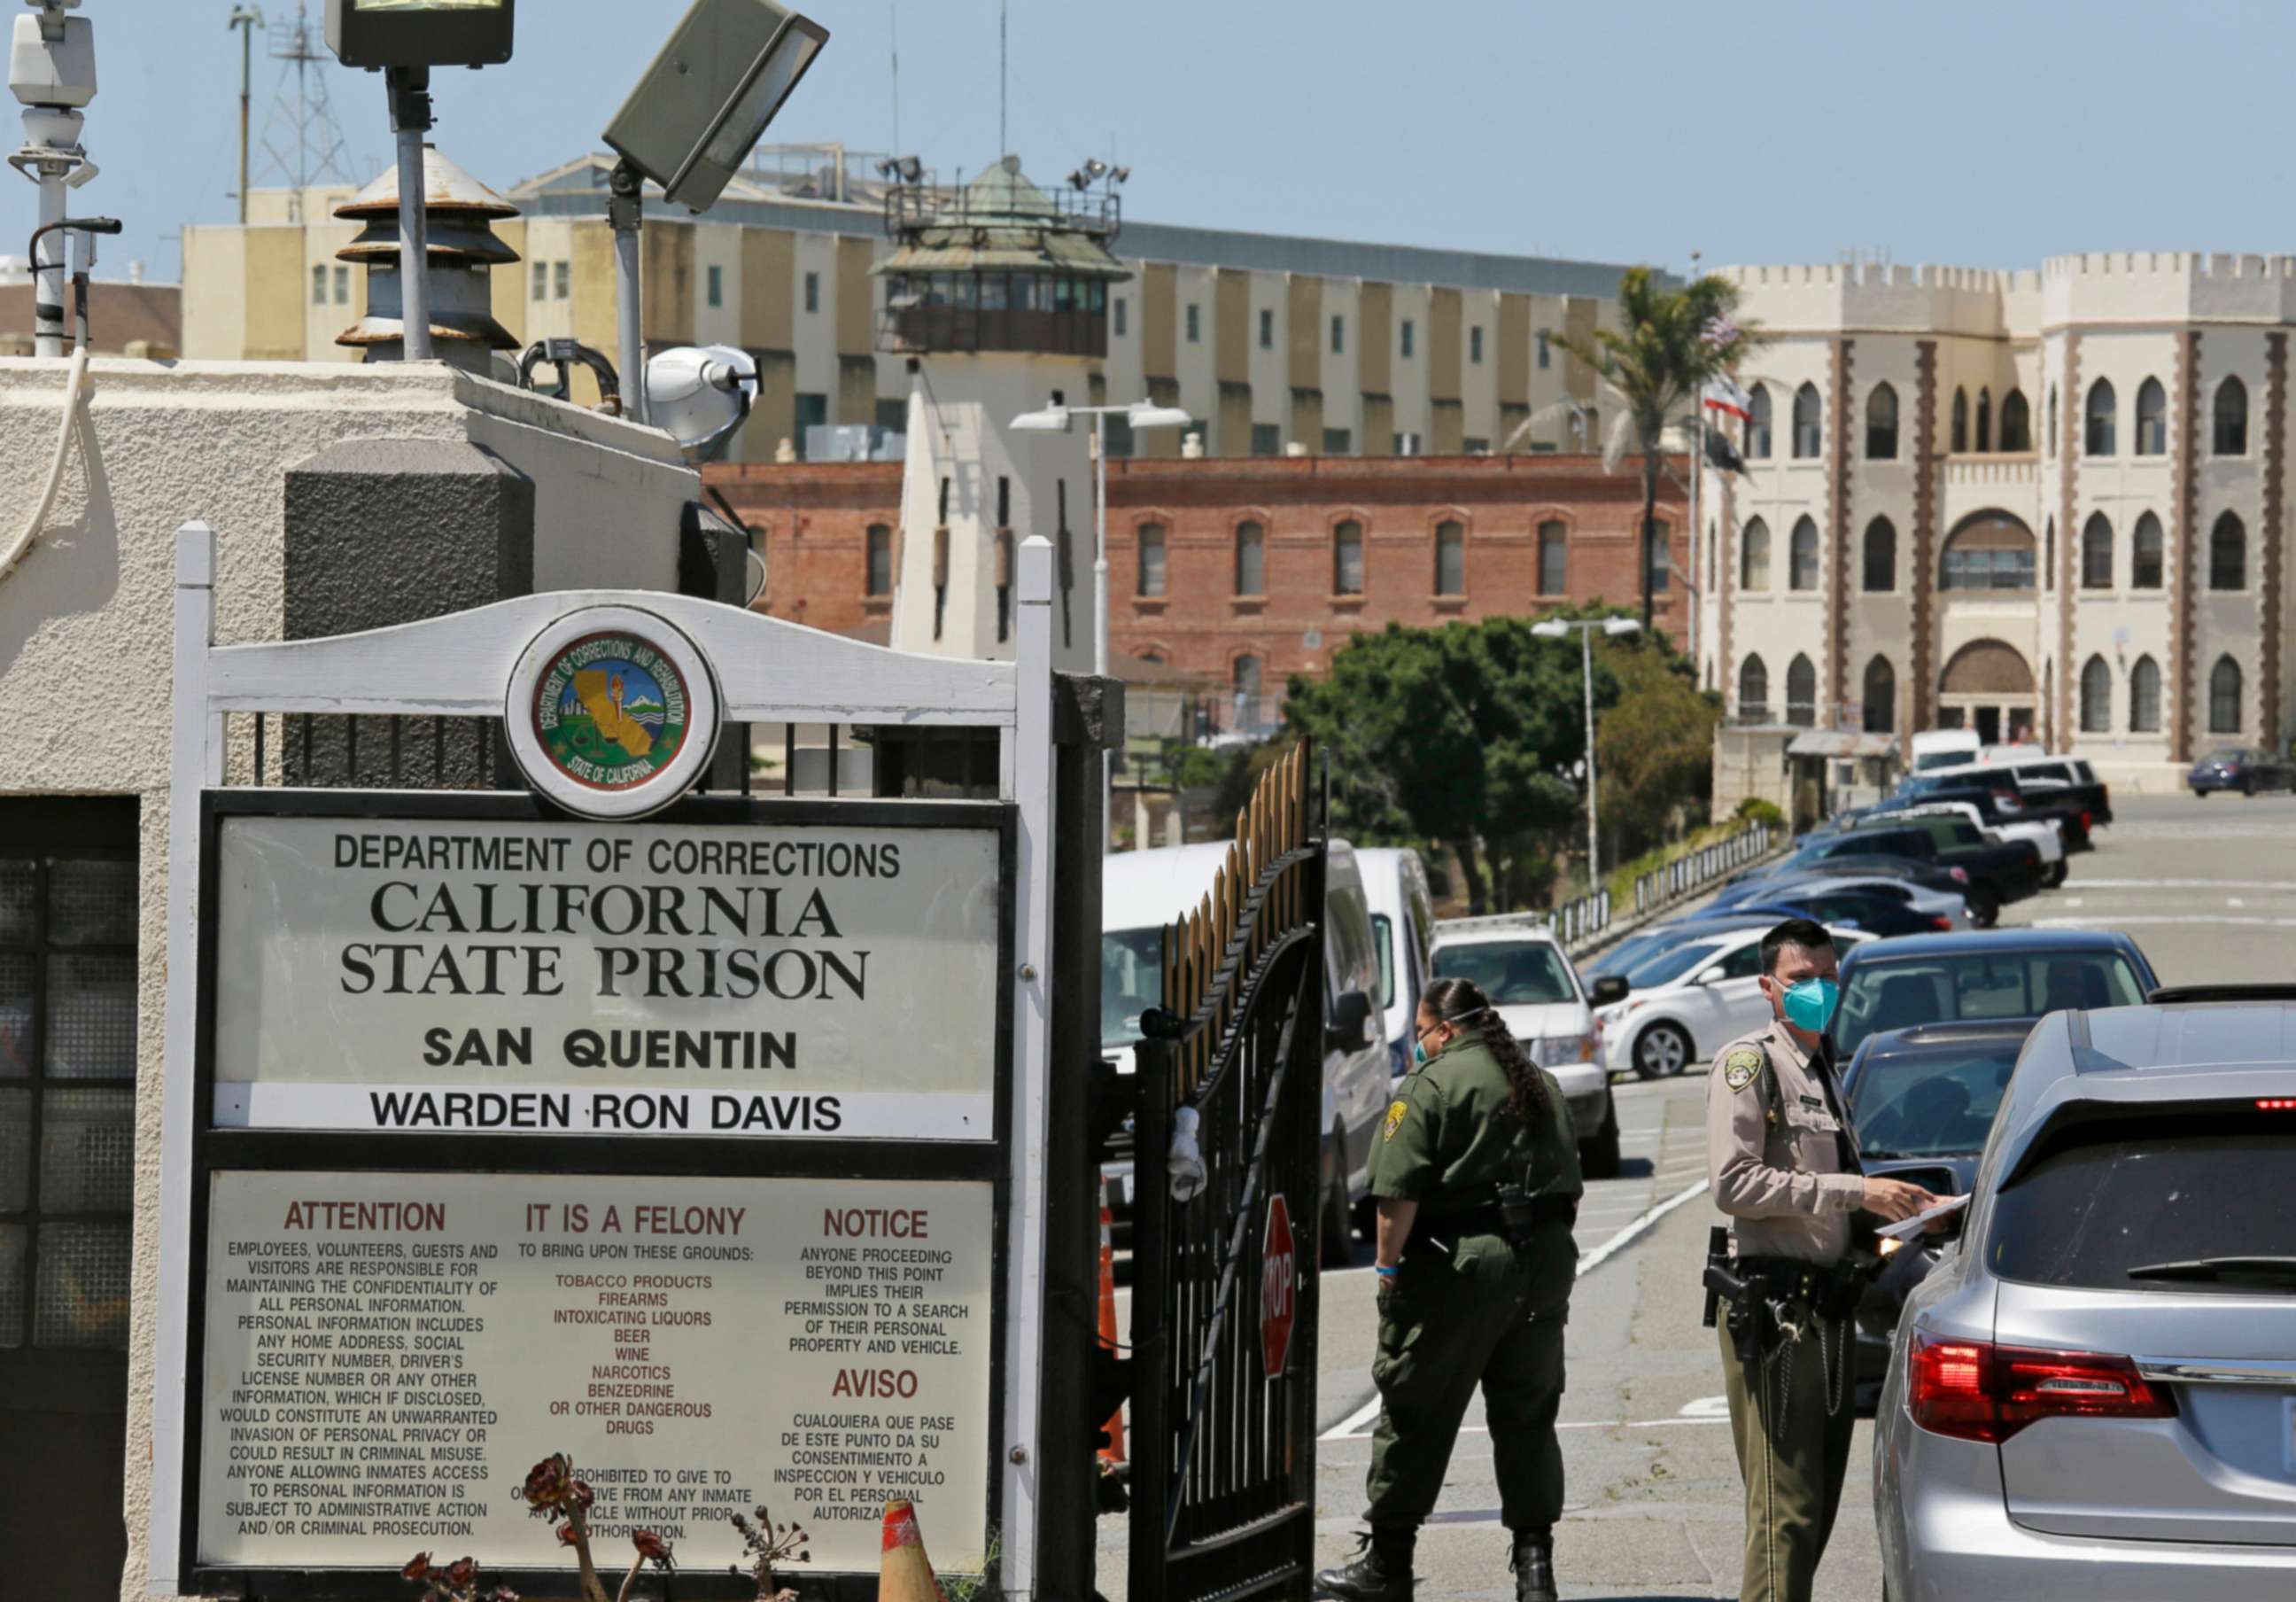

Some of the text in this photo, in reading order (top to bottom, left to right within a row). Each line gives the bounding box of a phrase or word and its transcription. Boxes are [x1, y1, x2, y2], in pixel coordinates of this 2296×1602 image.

[539, 673, 567, 730] DEPARTMENT
[559, 657, 574, 675] OF
[571, 640, 632, 666] CORRECTIONS
[634, 648, 654, 667] AND
[568, 755, 655, 783] STATE OF CALIFORNIA
[335, 835, 900, 877] DEPARTMENT OF CORRECTIONS
[370, 883, 842, 937] CALIFORNIA
[341, 944, 870, 999] STATE PRISON
[423, 1027, 796, 1069] SAN QUENTIN
[370, 1093, 842, 1131] WARDEN RON DAVIS
[283, 1202, 445, 1231] ATTENTION
[526, 1203, 746, 1235] IT IS A FELONY
[824, 1209, 928, 1238] NOTICE
[229, 1242, 498, 1258] EMPLOYEES, VOLUNTEERS, GUESTS AND
[518, 1243, 754, 1261] TO BRING UPON THESE GROUNDS:
[801, 1248, 952, 1264] ANYONE PROCEEDING
[248, 1261, 478, 1277] VISITORS ARE RESPONSIBLE FOR
[806, 1265, 944, 1281] BEYOND THIS POINT
[227, 1279, 498, 1295] MAINTAINING THE CONFIDENTIALITY OF
[555, 1275, 712, 1288] TOBACCO PRODUCTS
[1260, 1252, 1292, 1321] STOP
[599, 1293, 668, 1306] FIREARMS
[826, 1284, 923, 1299] IMPLIES THEIR
[259, 1297, 465, 1312] ALL PERSONAL INFORMATION.
[785, 1302, 968, 1318] PERMISSION TO A SEARCH
[238, 1316, 484, 1332] PERSONAL INFORMATION INCLUDES
[554, 1310, 712, 1326] INTOXICATING LIQUORS
[614, 1329, 650, 1342] BEER
[804, 1319, 947, 1336] OF THEIR PERSONAL
[257, 1334, 464, 1350] ANY HOME ADDRESS, SOCIAL
[789, 1338, 962, 1354] PROPERTY AND VEHICLE.
[257, 1353, 463, 1368] SECURITY NUMBER, DRIVER'S
[615, 1348, 649, 1361] WINE
[242, 1372, 477, 1388] LICENSE NUMBER OR ANY OTHER
[592, 1365, 671, 1380] NARCOTICS
[588, 1384, 673, 1398] BENZEDRINE
[832, 1369, 918, 1398] AVISO
[232, 1390, 485, 1406] INFORMATION, WHICH IF DISCLOSED,
[220, 1408, 498, 1425] WOULD CONSTITUTE AN UNWARRANTED
[549, 1401, 712, 1418] OR OTHER DANGEROUS
[606, 1420, 654, 1435] DRUGS
[794, 1414, 955, 1430] CUALQUIERA QUE PASE
[230, 1427, 486, 1443] INVASION OF PERSONAL PRIVACY OR
[781, 1433, 939, 1449] DE ESTE PUNTO DA SU
[229, 1446, 486, 1461] COULD RESULT IN CRIMINAL MISUSE.
[792, 1450, 928, 1466] CONSENTIMIENTO A
[227, 1465, 489, 1480] ANYONE ALLOWING INMATES ACCESS
[653, 1470, 671, 1483] TO
[677, 1470, 708, 1484] GIVE
[713, 1470, 732, 1484] TO
[774, 1469, 944, 1485] INSPECCION Y VEHICULO
[250, 1483, 464, 1498] TO PERSONAL INFORMATION IS
[624, 1488, 663, 1502] FROM
[668, 1489, 696, 1502] ANY
[702, 1489, 751, 1503] INMATE
[794, 1488, 823, 1501] POR
[828, 1488, 845, 1502] EL
[226, 1502, 487, 1517] SUBJECT TO ADMINISTRATIVE ACTION
[624, 1506, 687, 1520] WITHOUT
[692, 1507, 733, 1520] PRIOR
[237, 1520, 474, 1536] AND/OR CRIMINAL PROSECUTION.
